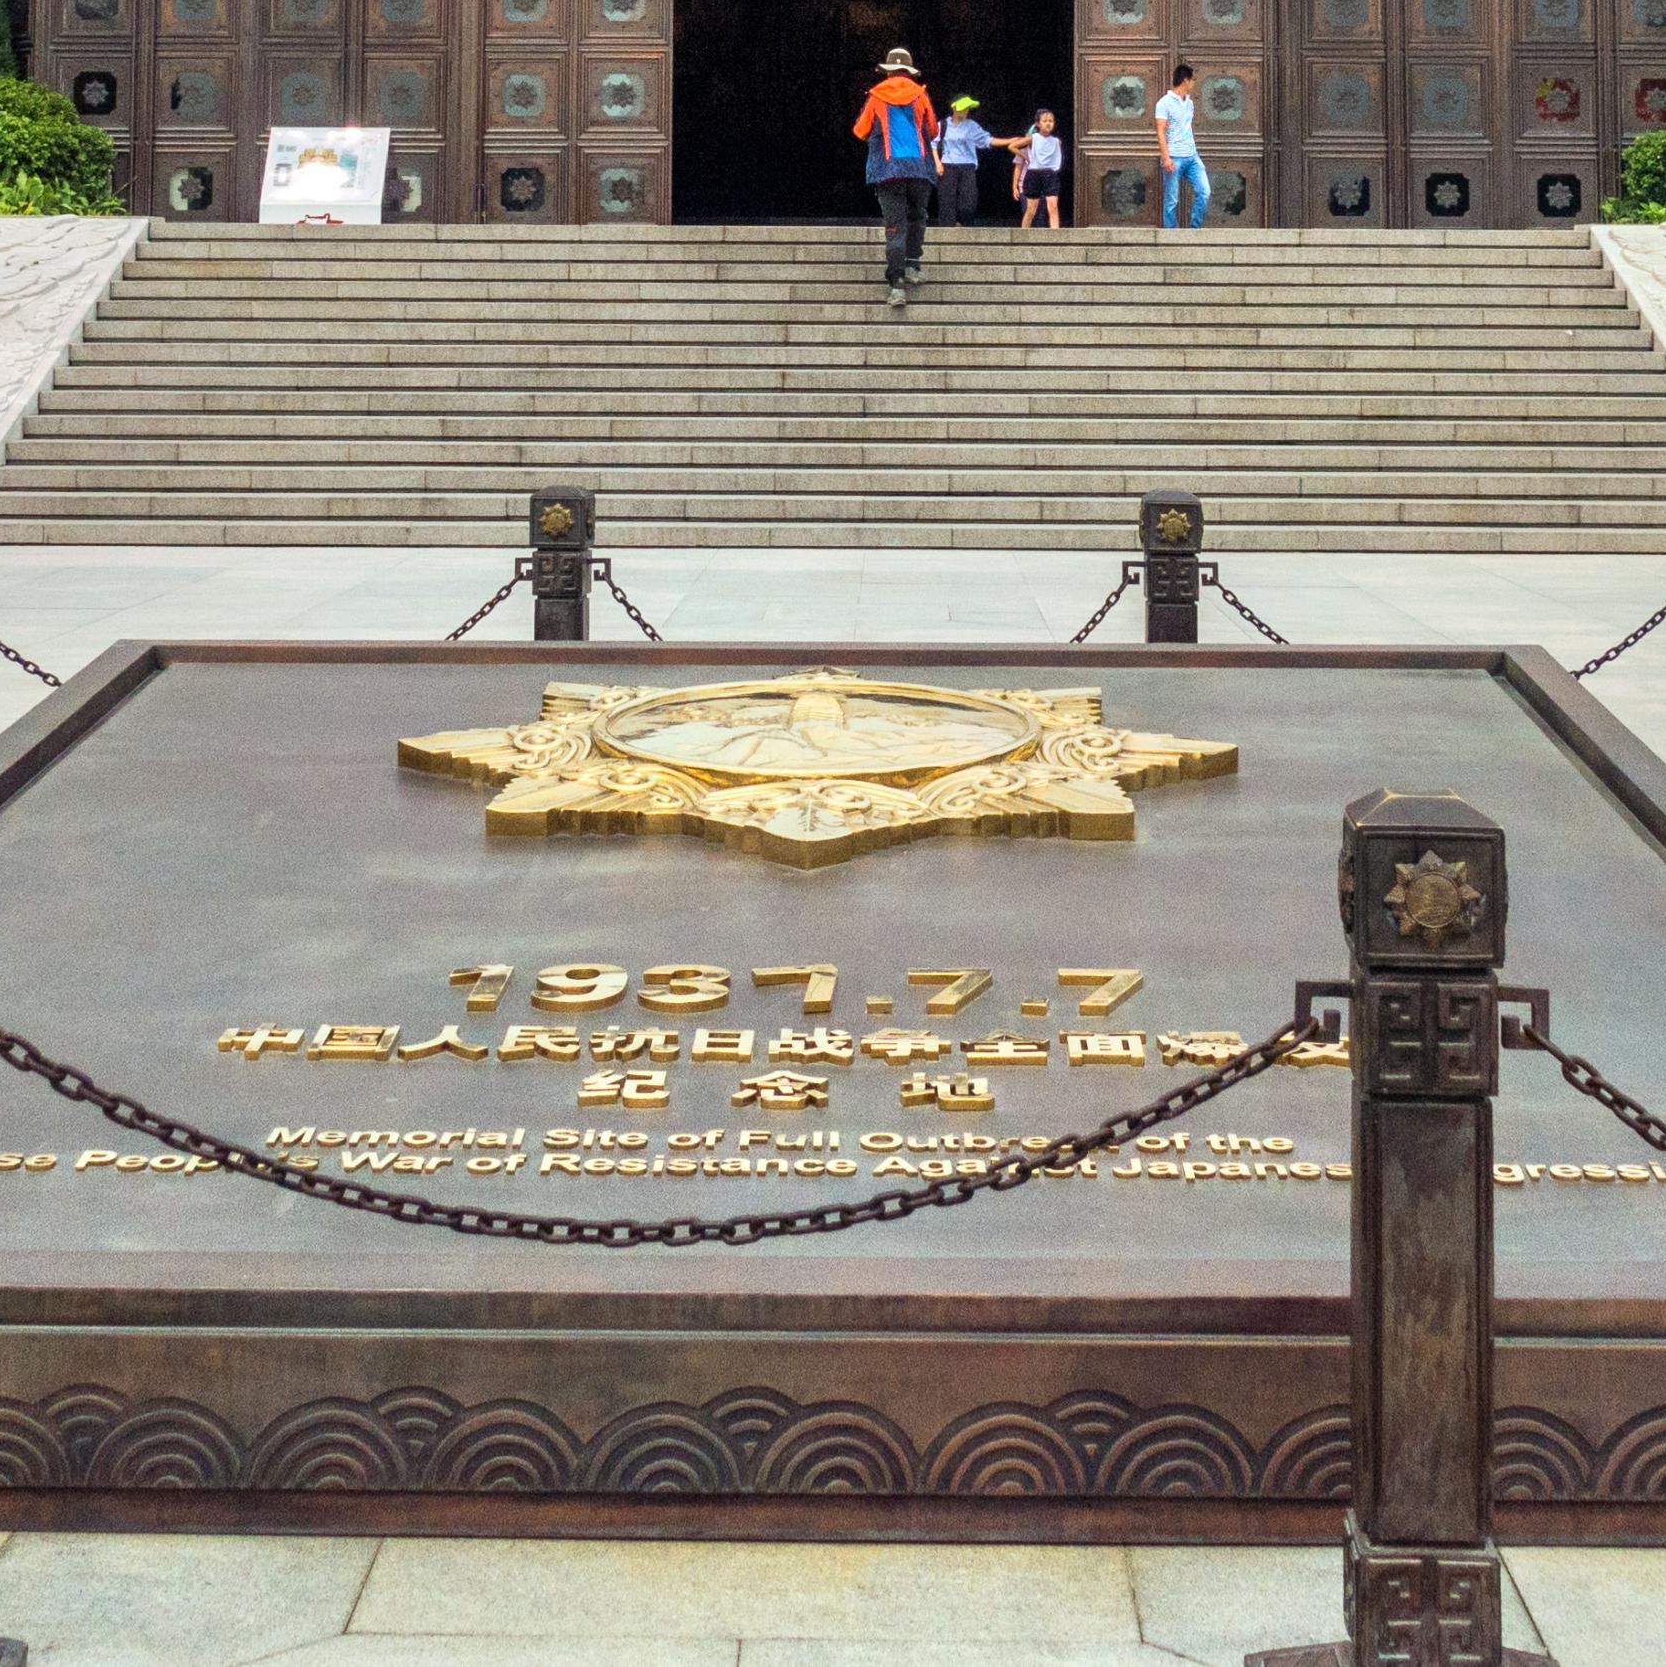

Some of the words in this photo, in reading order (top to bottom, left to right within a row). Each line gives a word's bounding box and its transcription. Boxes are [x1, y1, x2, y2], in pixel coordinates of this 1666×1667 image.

[265, 1126, 526, 1150] Memorial
[542, 1128, 649, 1151] Site
[667, 1129, 726, 1152] of
[738, 1130, 841, 1152] Full
[859, 1132, 1120, 1154] Outbre
[1135, 1132, 1191, 1155] of
[1206, 1133, 1294, 1156] the
[340, 1151, 453, 1175] War
[466, 1153, 528, 1176] of
[539, 1153, 858, 1178] Resistance
[1112, 1157, 1353, 1184] Japanes
